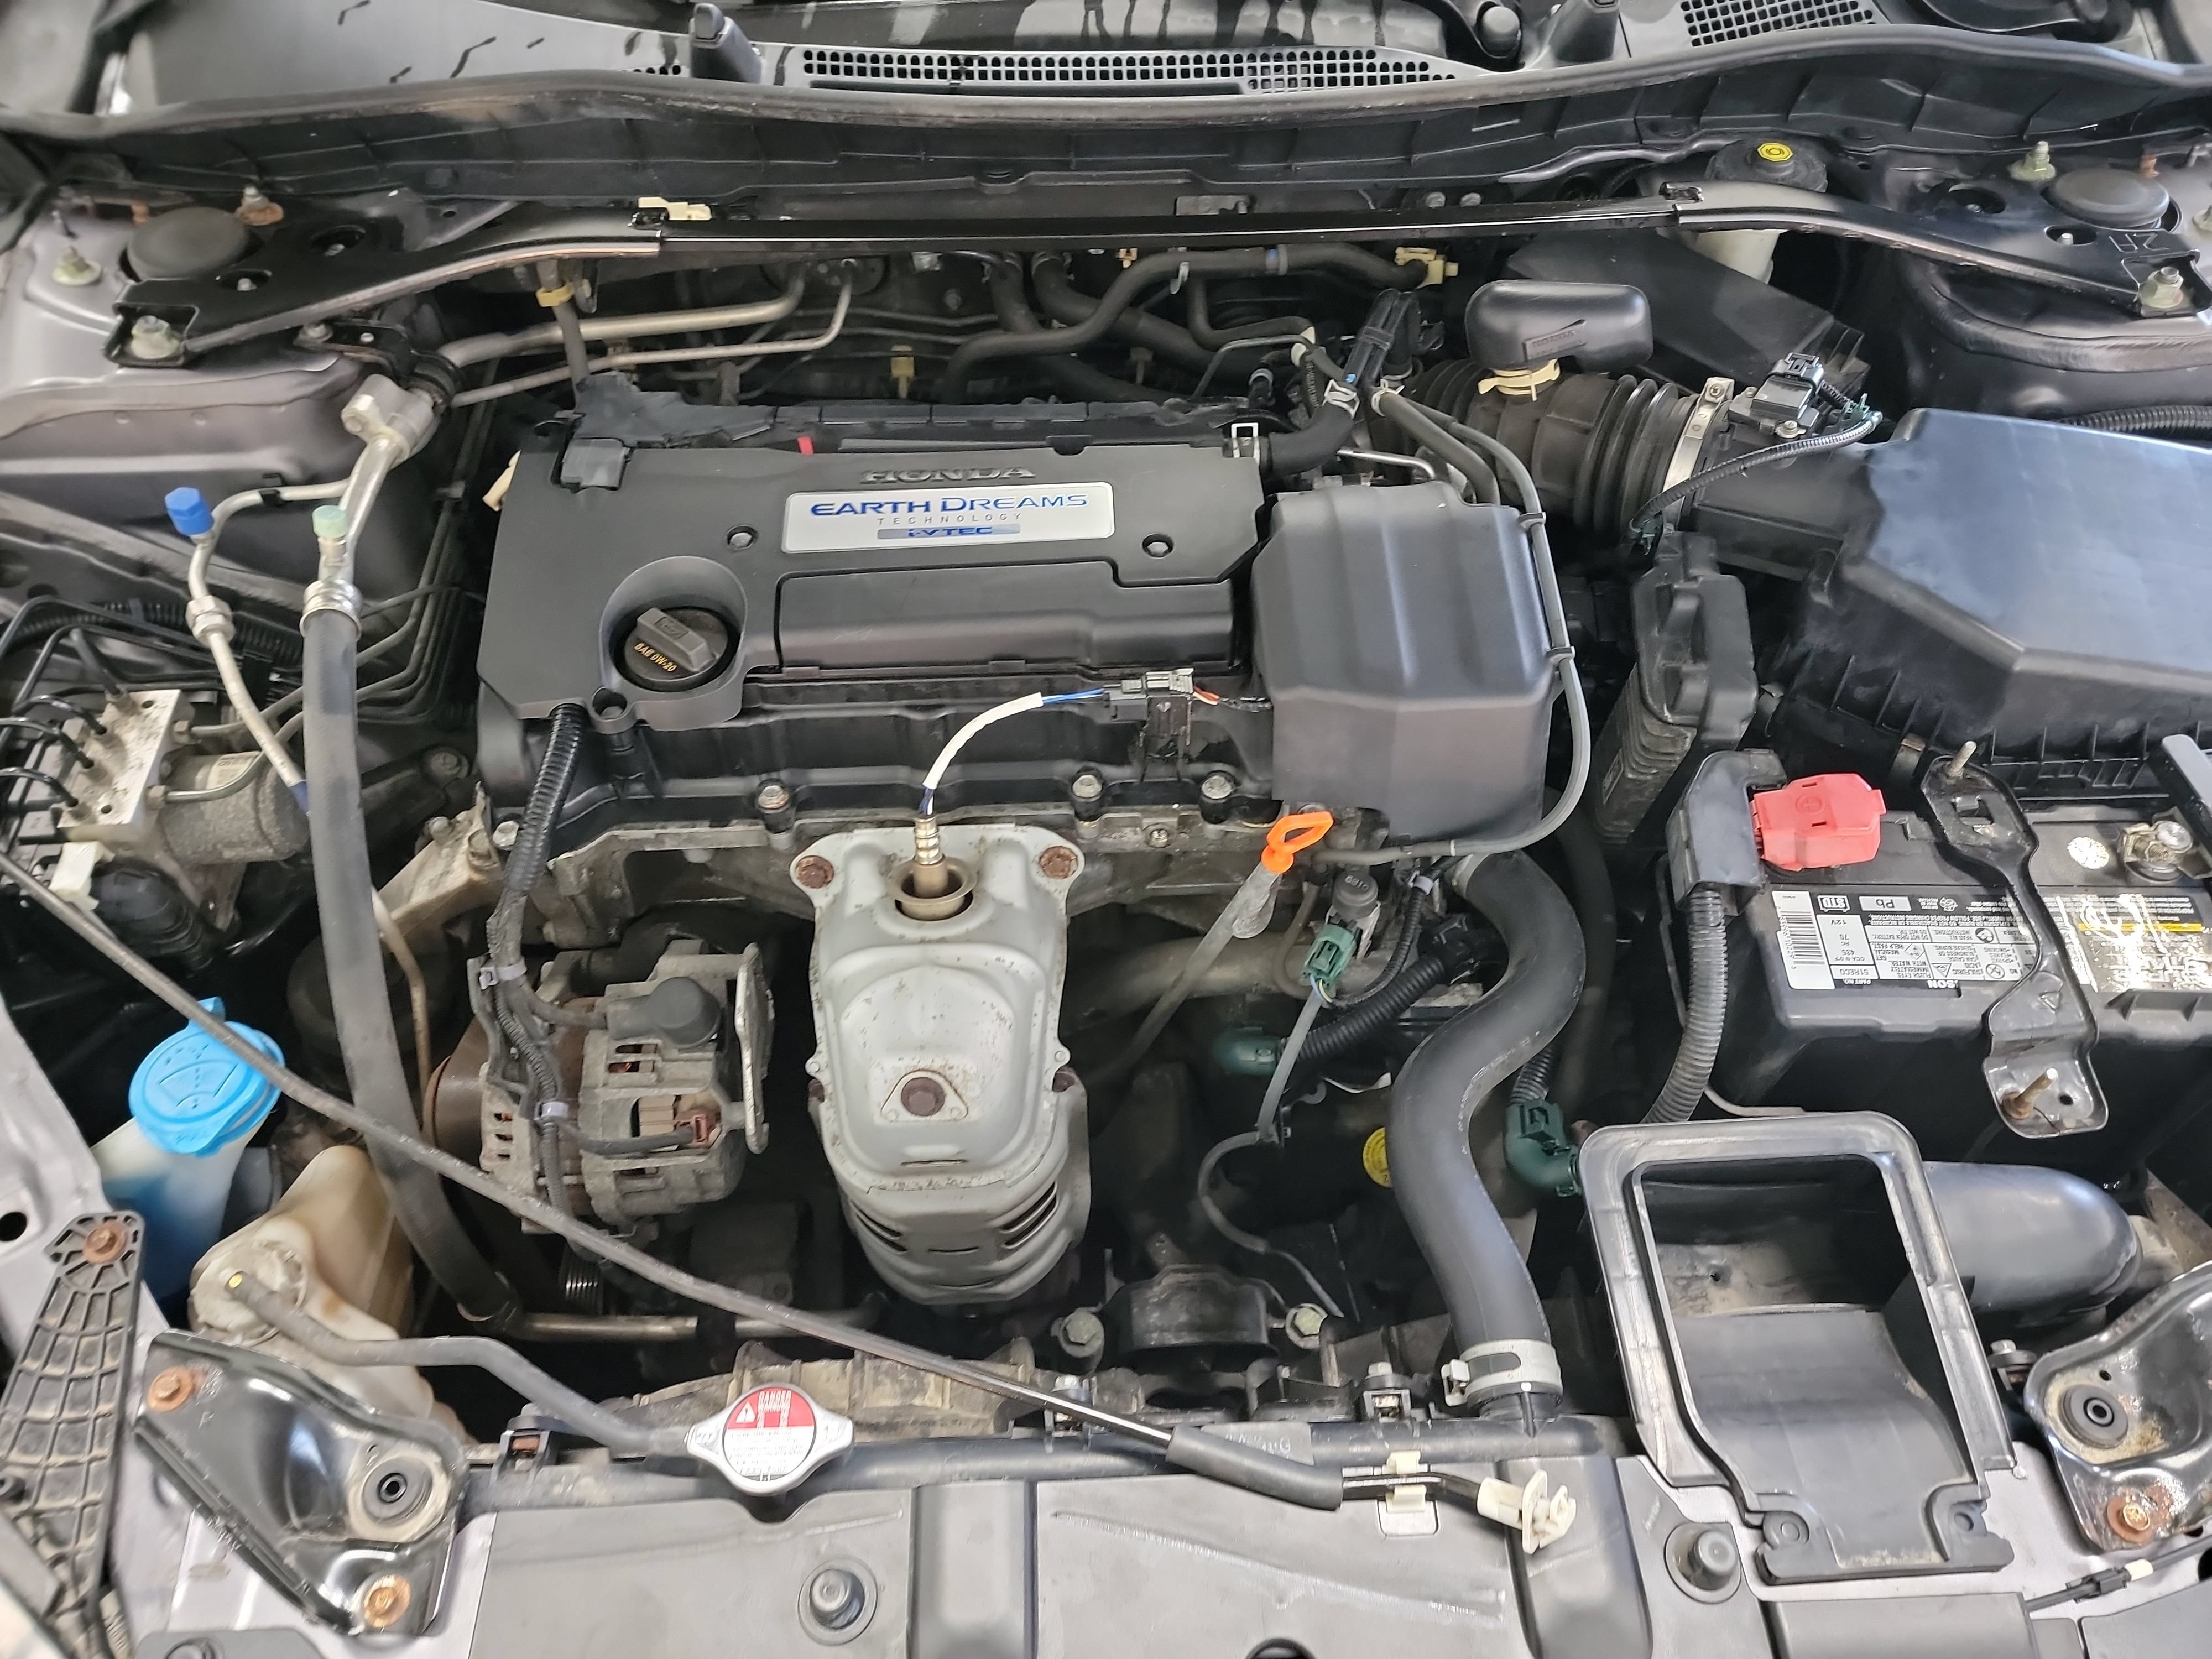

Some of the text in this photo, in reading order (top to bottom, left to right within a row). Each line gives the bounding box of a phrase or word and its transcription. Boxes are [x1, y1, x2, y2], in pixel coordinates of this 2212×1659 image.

[860, 467, 1037, 484] HONDA
[811, 493, 1089, 517] EARTH DREAMS
[877, 512, 1023, 525] TECHNOLOGY
[650, 653, 678, 672] 0W-20
[1822, 898, 1845, 908] STD
[1875, 899, 1895, 909] Pb
